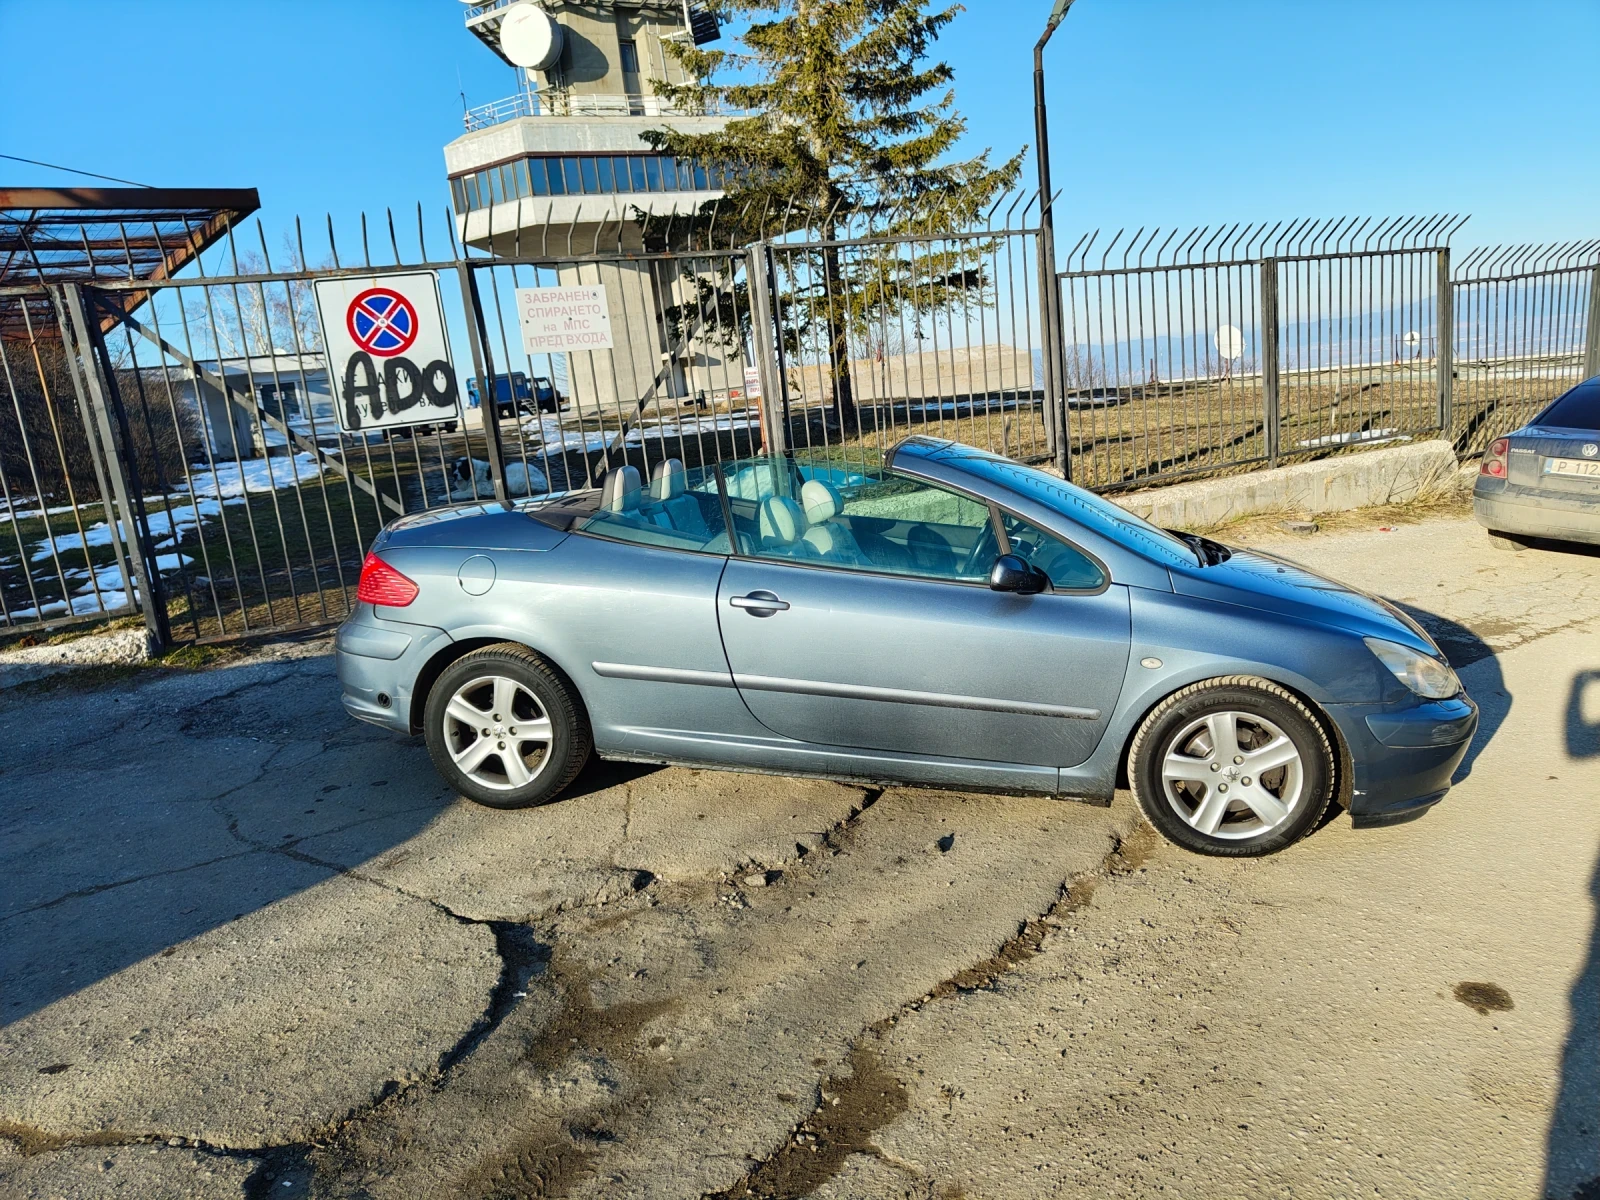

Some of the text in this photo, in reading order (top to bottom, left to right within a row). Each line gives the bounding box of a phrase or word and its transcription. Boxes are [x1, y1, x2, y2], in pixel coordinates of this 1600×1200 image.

[525, 290, 598, 304] ЗАБРАНЕН
[527, 304, 601, 318] СПИРАНЕТО
[543, 319, 590, 332] на МПС
[529, 332, 608, 348] ПРЕД ВХОДА
[1575, 462, 1600, 476] 112
[1203, 695, 1265, 707] MICHELIN
[1202, 843, 1262, 855] MICHELIN
